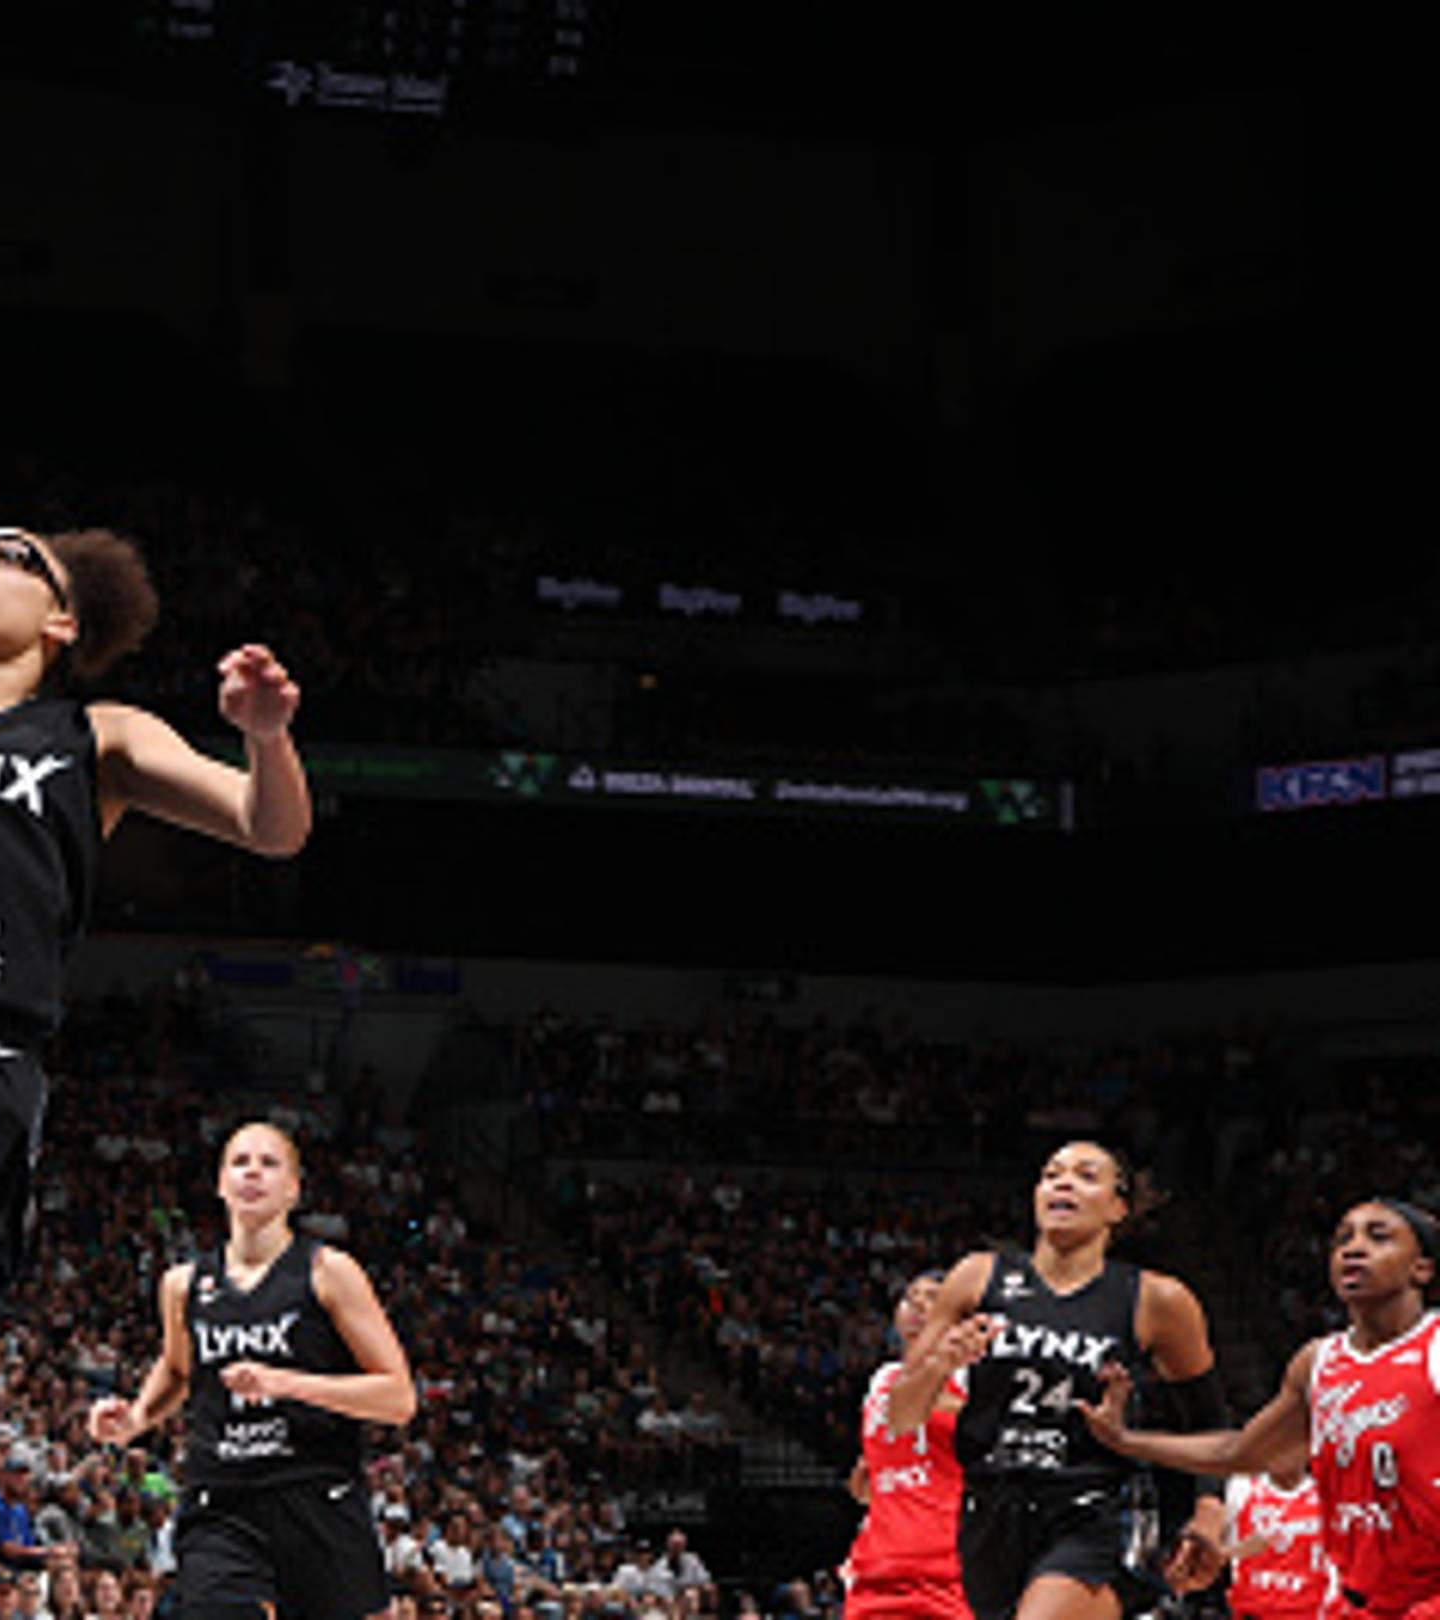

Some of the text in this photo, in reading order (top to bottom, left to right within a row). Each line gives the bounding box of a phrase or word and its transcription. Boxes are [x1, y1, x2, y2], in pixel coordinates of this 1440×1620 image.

[193, 1308, 301, 1364] LYNX
[991, 1312, 1118, 1372] LYNX
[1011, 1367, 1076, 1415] 24
[1372, 1441, 1399, 1489] 0
